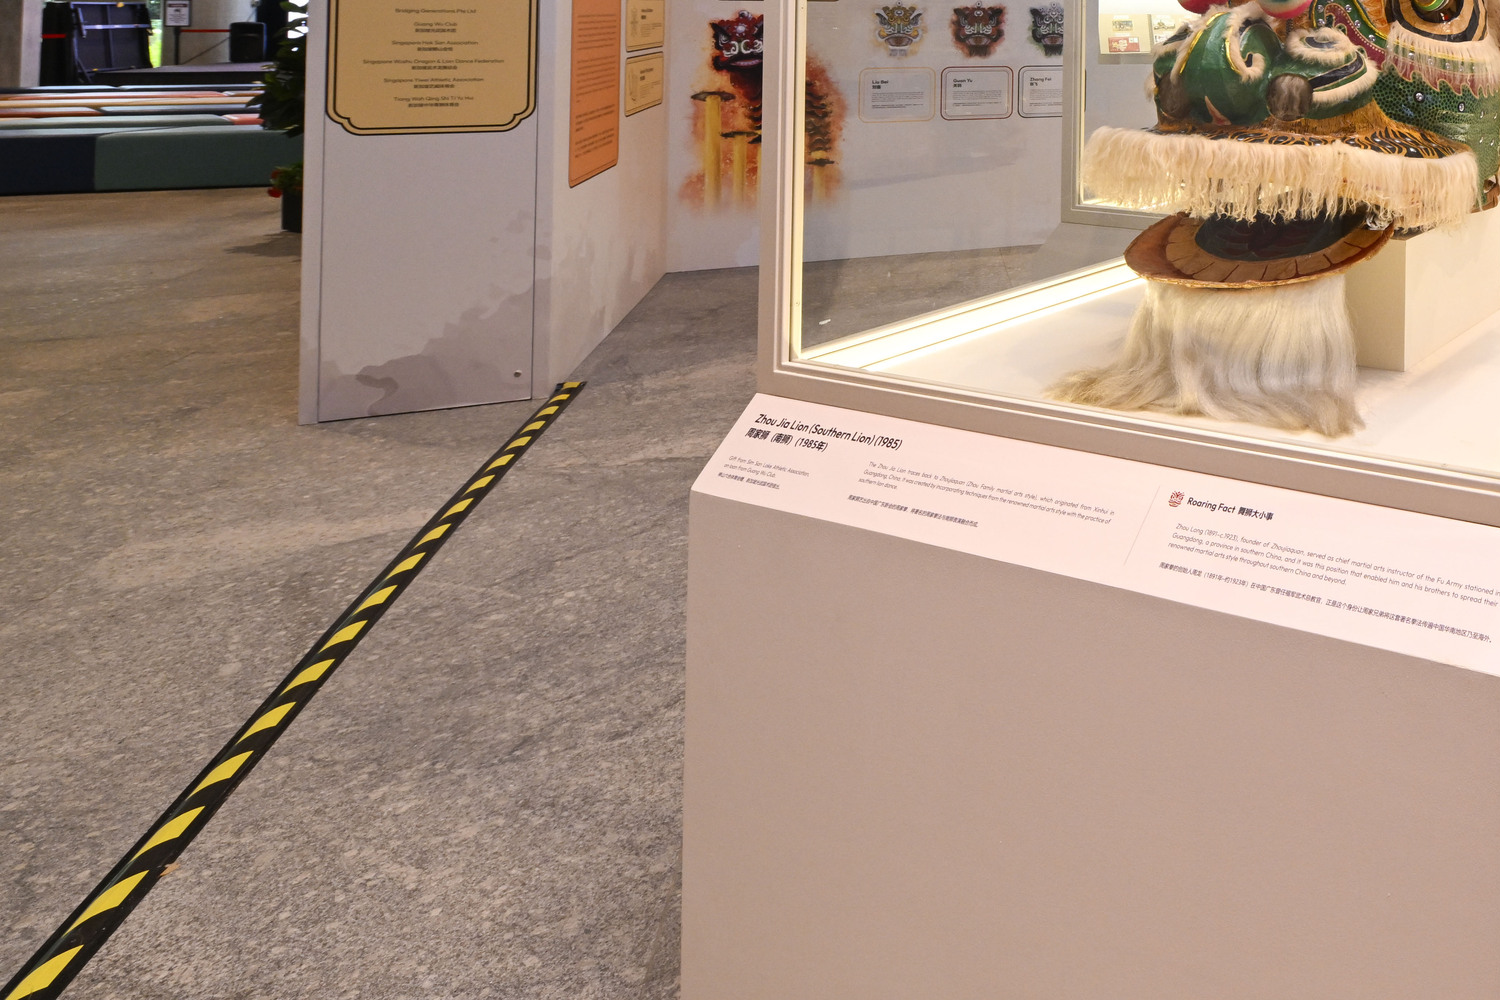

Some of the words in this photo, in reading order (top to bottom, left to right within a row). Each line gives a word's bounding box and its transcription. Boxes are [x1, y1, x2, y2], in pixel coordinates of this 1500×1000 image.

[754, 414, 778, 426] Zhou
[775, 418, 791, 428] Jia
[789, 420, 809, 432] Lion
[808, 424, 852, 440] (Southern
[851, 432, 876, 445] Lion)
[874, 436, 903, 450] (1985)
[1187, 497, 1217, 512] Roaring
[1217, 503, 1236, 513] Fact
[1168, 543, 1195, 552] renowned
[1194, 547, 1215, 556] martial
[1239, 557, 1270, 568] throughout
[1269, 563, 1294, 574] southern
[1295, 568, 1312, 577] China
[1176, 523, 1190, 531] Zhou
[1190, 526, 1204, 535] Long
[1238, 536, 1262, 546] founder
[1262, 541, 1271, 549] of
[1306, 552, 1327, 561] served
[1335, 556, 1351, 564] chief
[1351, 561, 1373, 569] martial
[1373, 563, 1385, 572] arts
[1386, 567, 1415, 578] instructor
[1445, 580, 1463, 589] Army
[1464, 584, 1494, 595] stationed
[1209, 542, 1233, 551] province
[1240, 548, 1264, 557] southern
[1265, 552, 1283, 561] China,
[1325, 566, 1349, 575] position
[1363, 574, 1388, 583] enabled
[1388, 578, 1400, 586] him
[1414, 583, 1423, 591] his
[1424, 585, 1450, 597] brothers
[1460, 593, 1483, 603] spread
[1484, 598, 1499, 607] their
